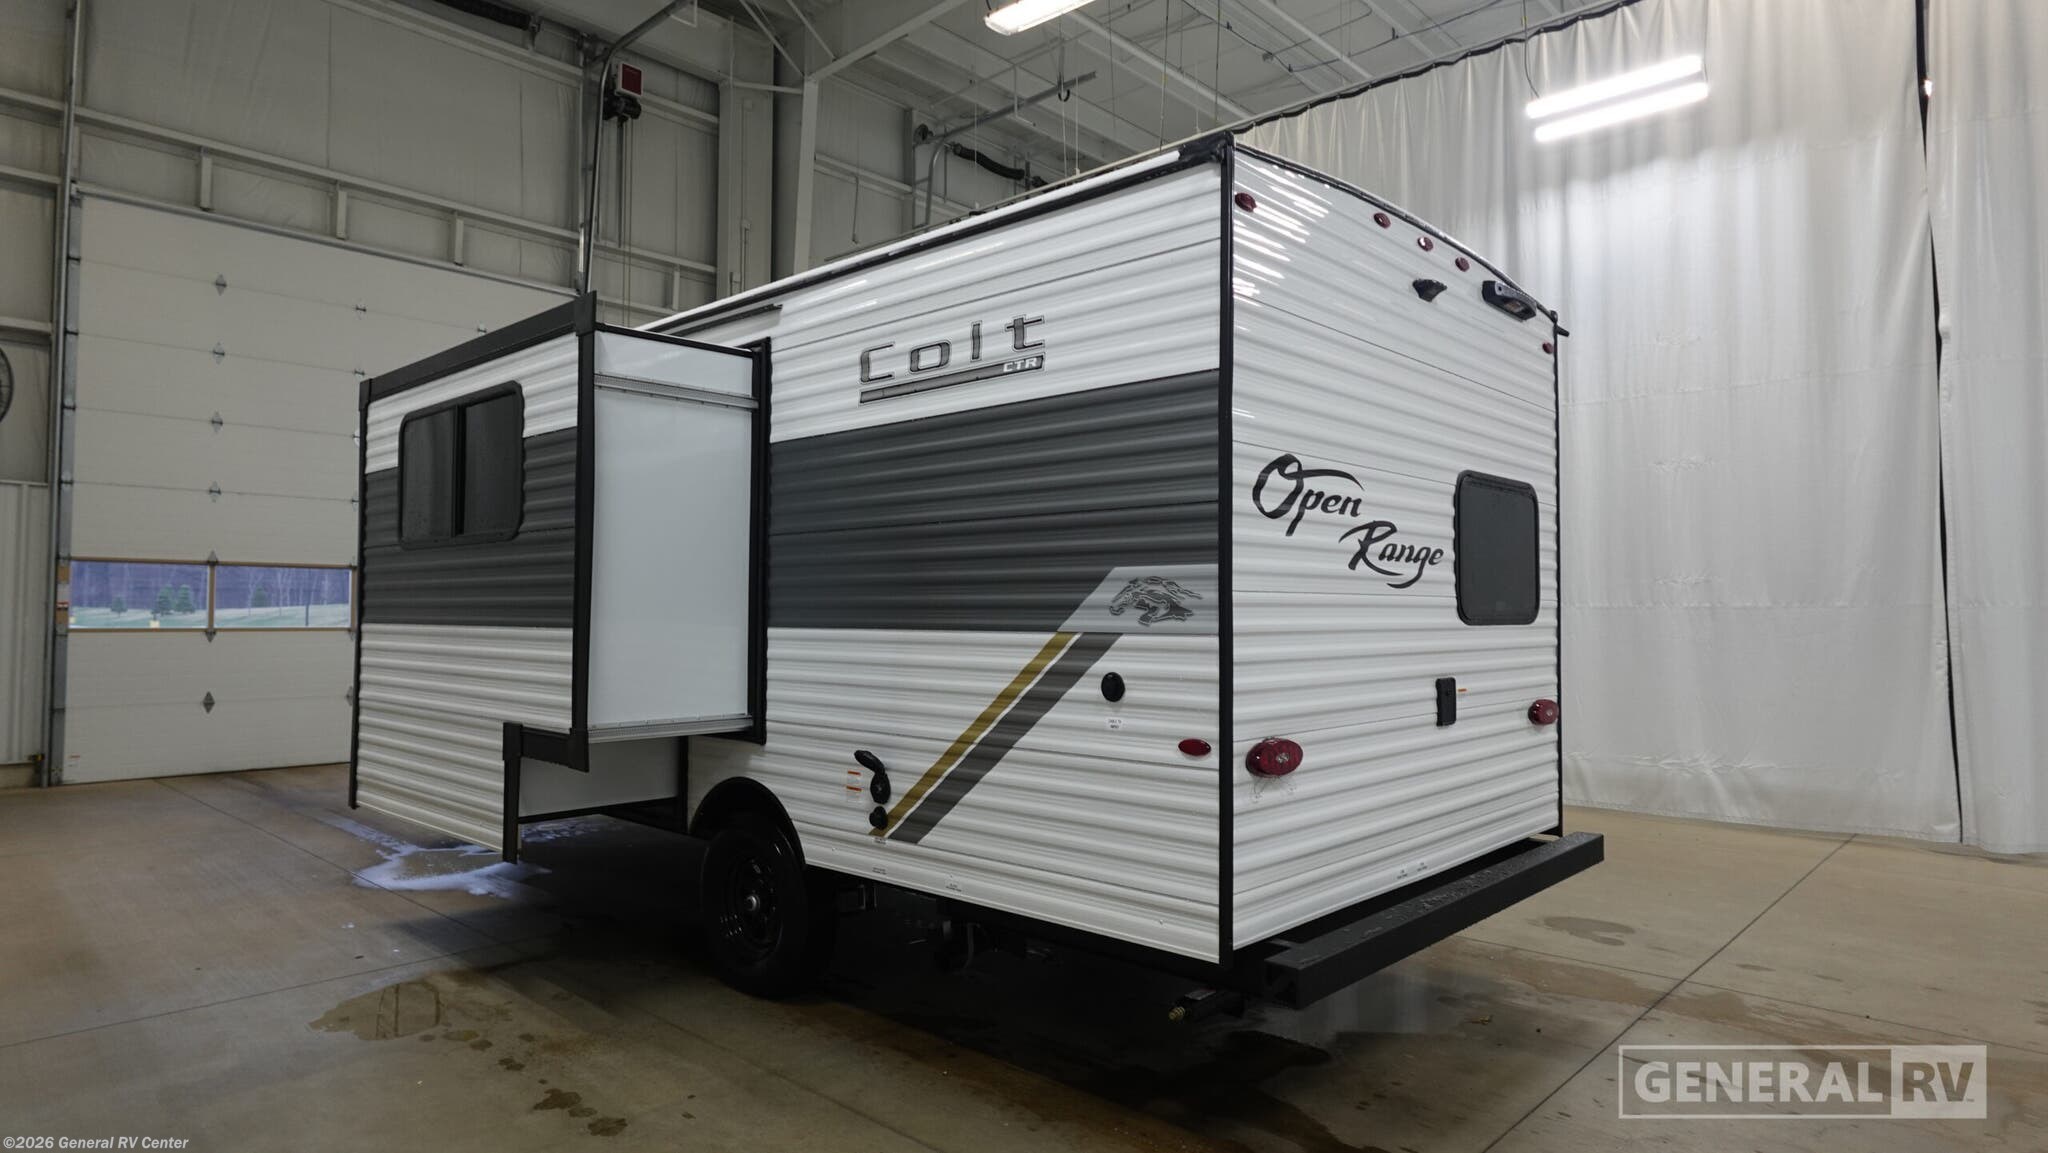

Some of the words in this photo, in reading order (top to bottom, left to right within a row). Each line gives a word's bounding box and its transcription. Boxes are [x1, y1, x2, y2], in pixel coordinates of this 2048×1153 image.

[859, 316, 1044, 383] Colt
[1003, 357, 1038, 372] CTR
[1252, 453, 1365, 537] Open
[1338, 520, 1444, 589] Range
